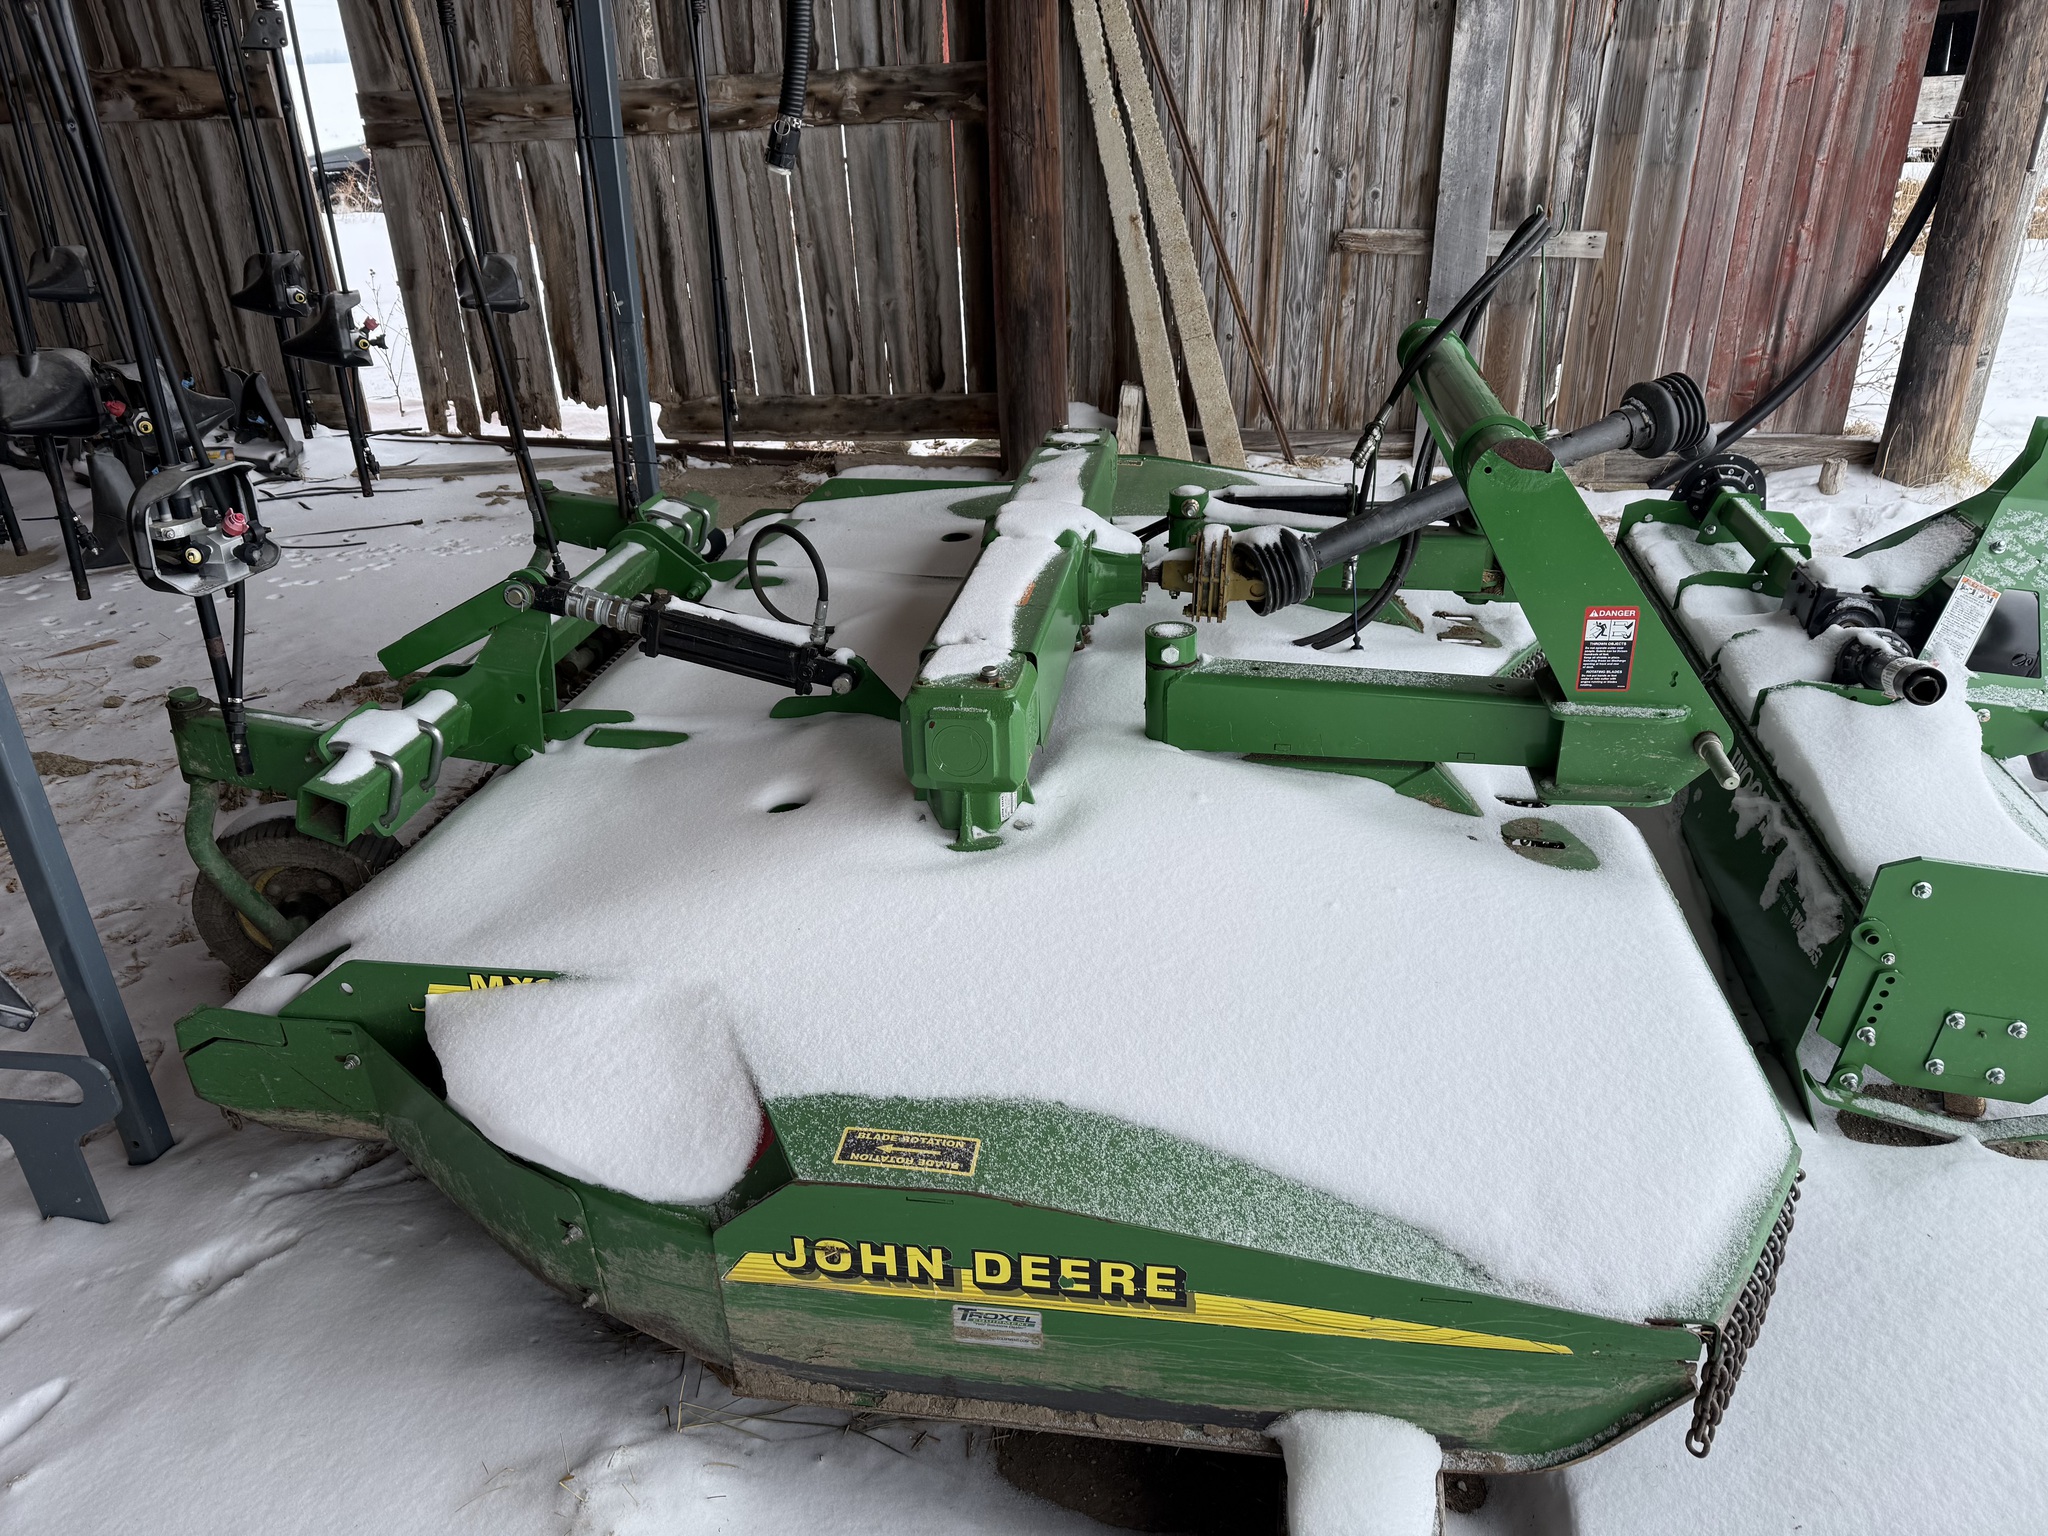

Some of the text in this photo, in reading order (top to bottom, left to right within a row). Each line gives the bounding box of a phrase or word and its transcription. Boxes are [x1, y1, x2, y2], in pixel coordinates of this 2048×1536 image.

[857, 1132, 965, 1148] BLADE ROTATION
[850, 1152, 960, 1170] BLADE ROTATION
[774, 1235, 1183, 1303] JOHN DEERE
[957, 1307, 1036, 1324] TROXEL
